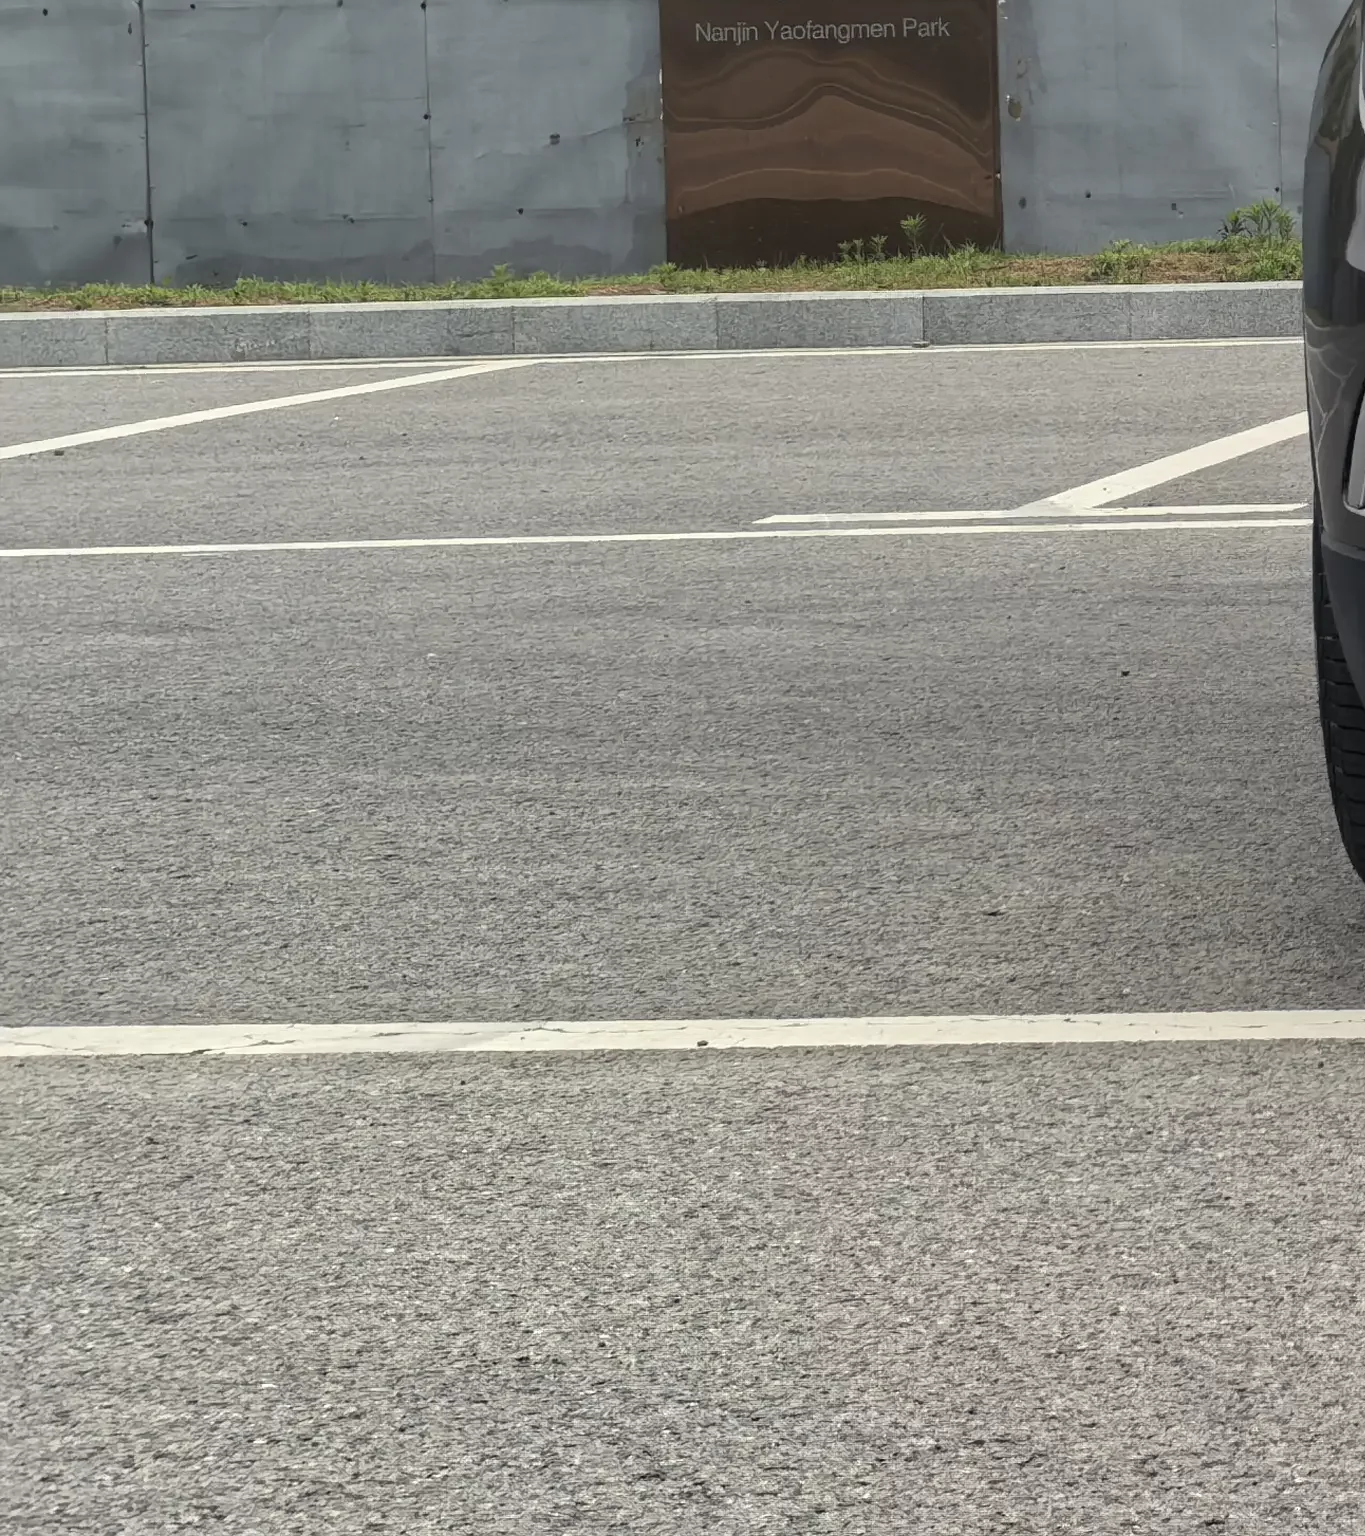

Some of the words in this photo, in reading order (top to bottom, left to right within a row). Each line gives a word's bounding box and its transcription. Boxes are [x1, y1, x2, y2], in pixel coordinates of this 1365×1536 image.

[696, 22, 758, 45] Nanjin
[764, 20, 895, 43] Yaofangmen
[903, 18, 950, 37] Park
